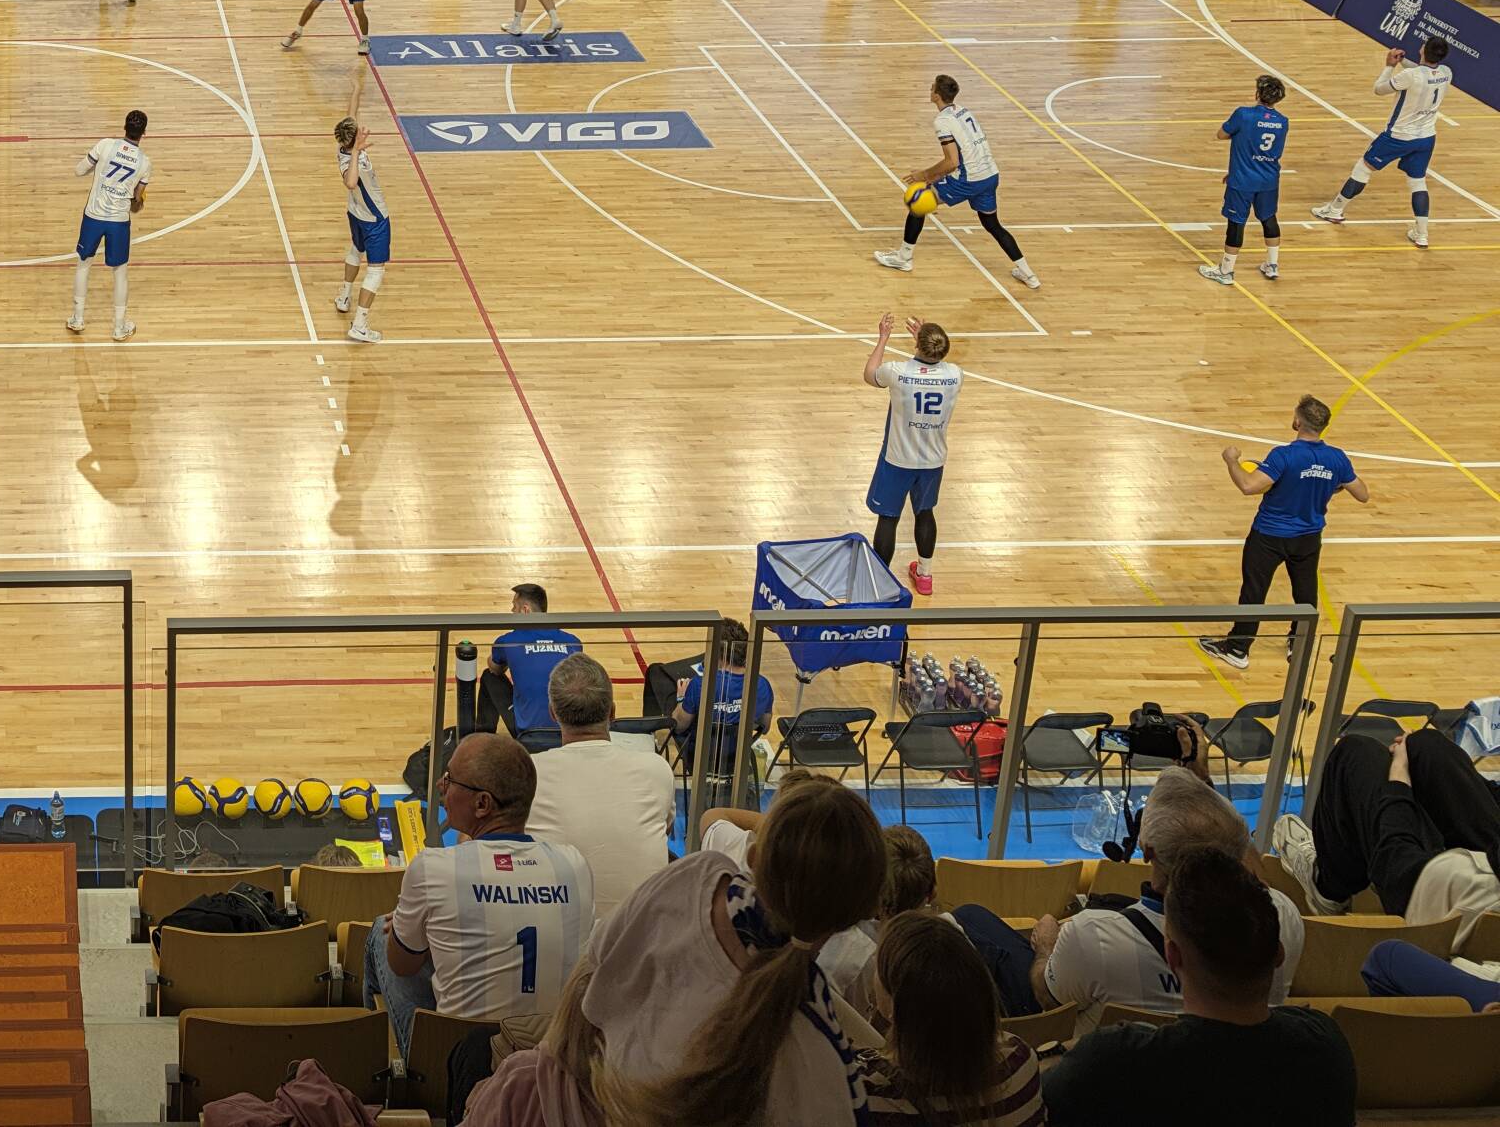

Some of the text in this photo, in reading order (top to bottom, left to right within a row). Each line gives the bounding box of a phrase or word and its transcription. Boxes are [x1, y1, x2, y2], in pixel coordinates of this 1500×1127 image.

[388, 39, 620, 59] Allaris
[1432, 88, 1439, 104] 1
[965, 117, 977, 133] 7
[1259, 133, 1276, 151] 3
[106, 160, 136, 183] 77
[913, 391, 944, 415] 12
[472, 883, 569, 904] WALIŃSKI
[516, 926, 538, 993] 1
